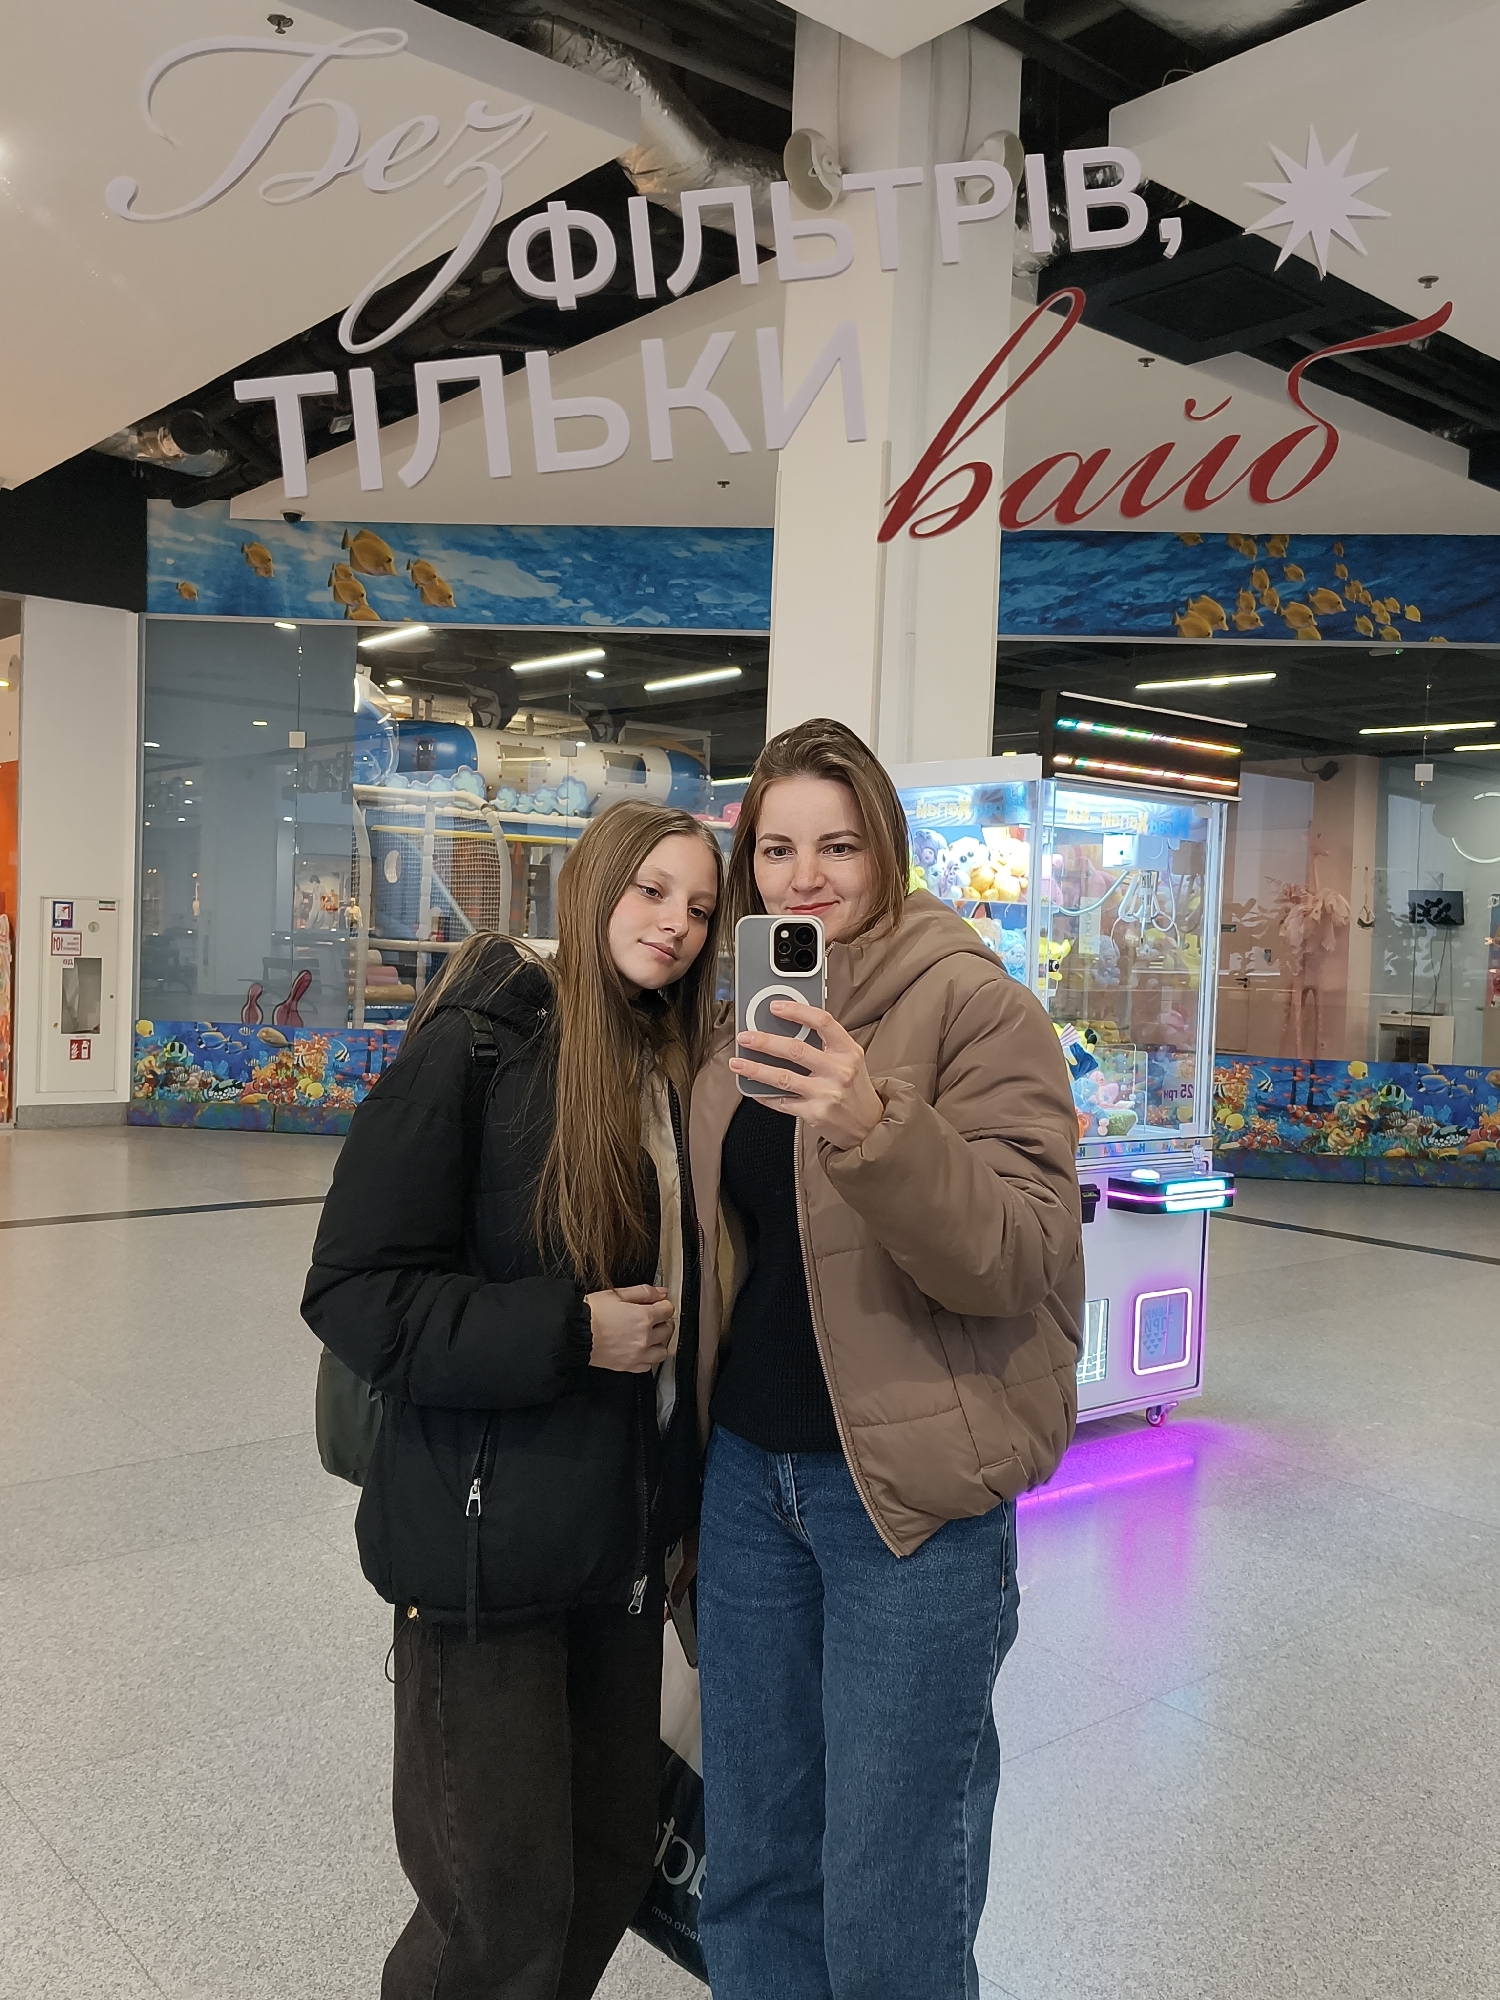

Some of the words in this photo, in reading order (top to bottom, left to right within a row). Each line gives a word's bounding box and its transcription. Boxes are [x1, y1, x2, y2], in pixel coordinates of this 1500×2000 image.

[105, 27, 548, 354] Без
[507, 146, 1183, 311] ФІЛЬТРІВ,
[234, 320, 868, 499] ТІЛЬКИ
[877, 286, 1453, 544] вайб
